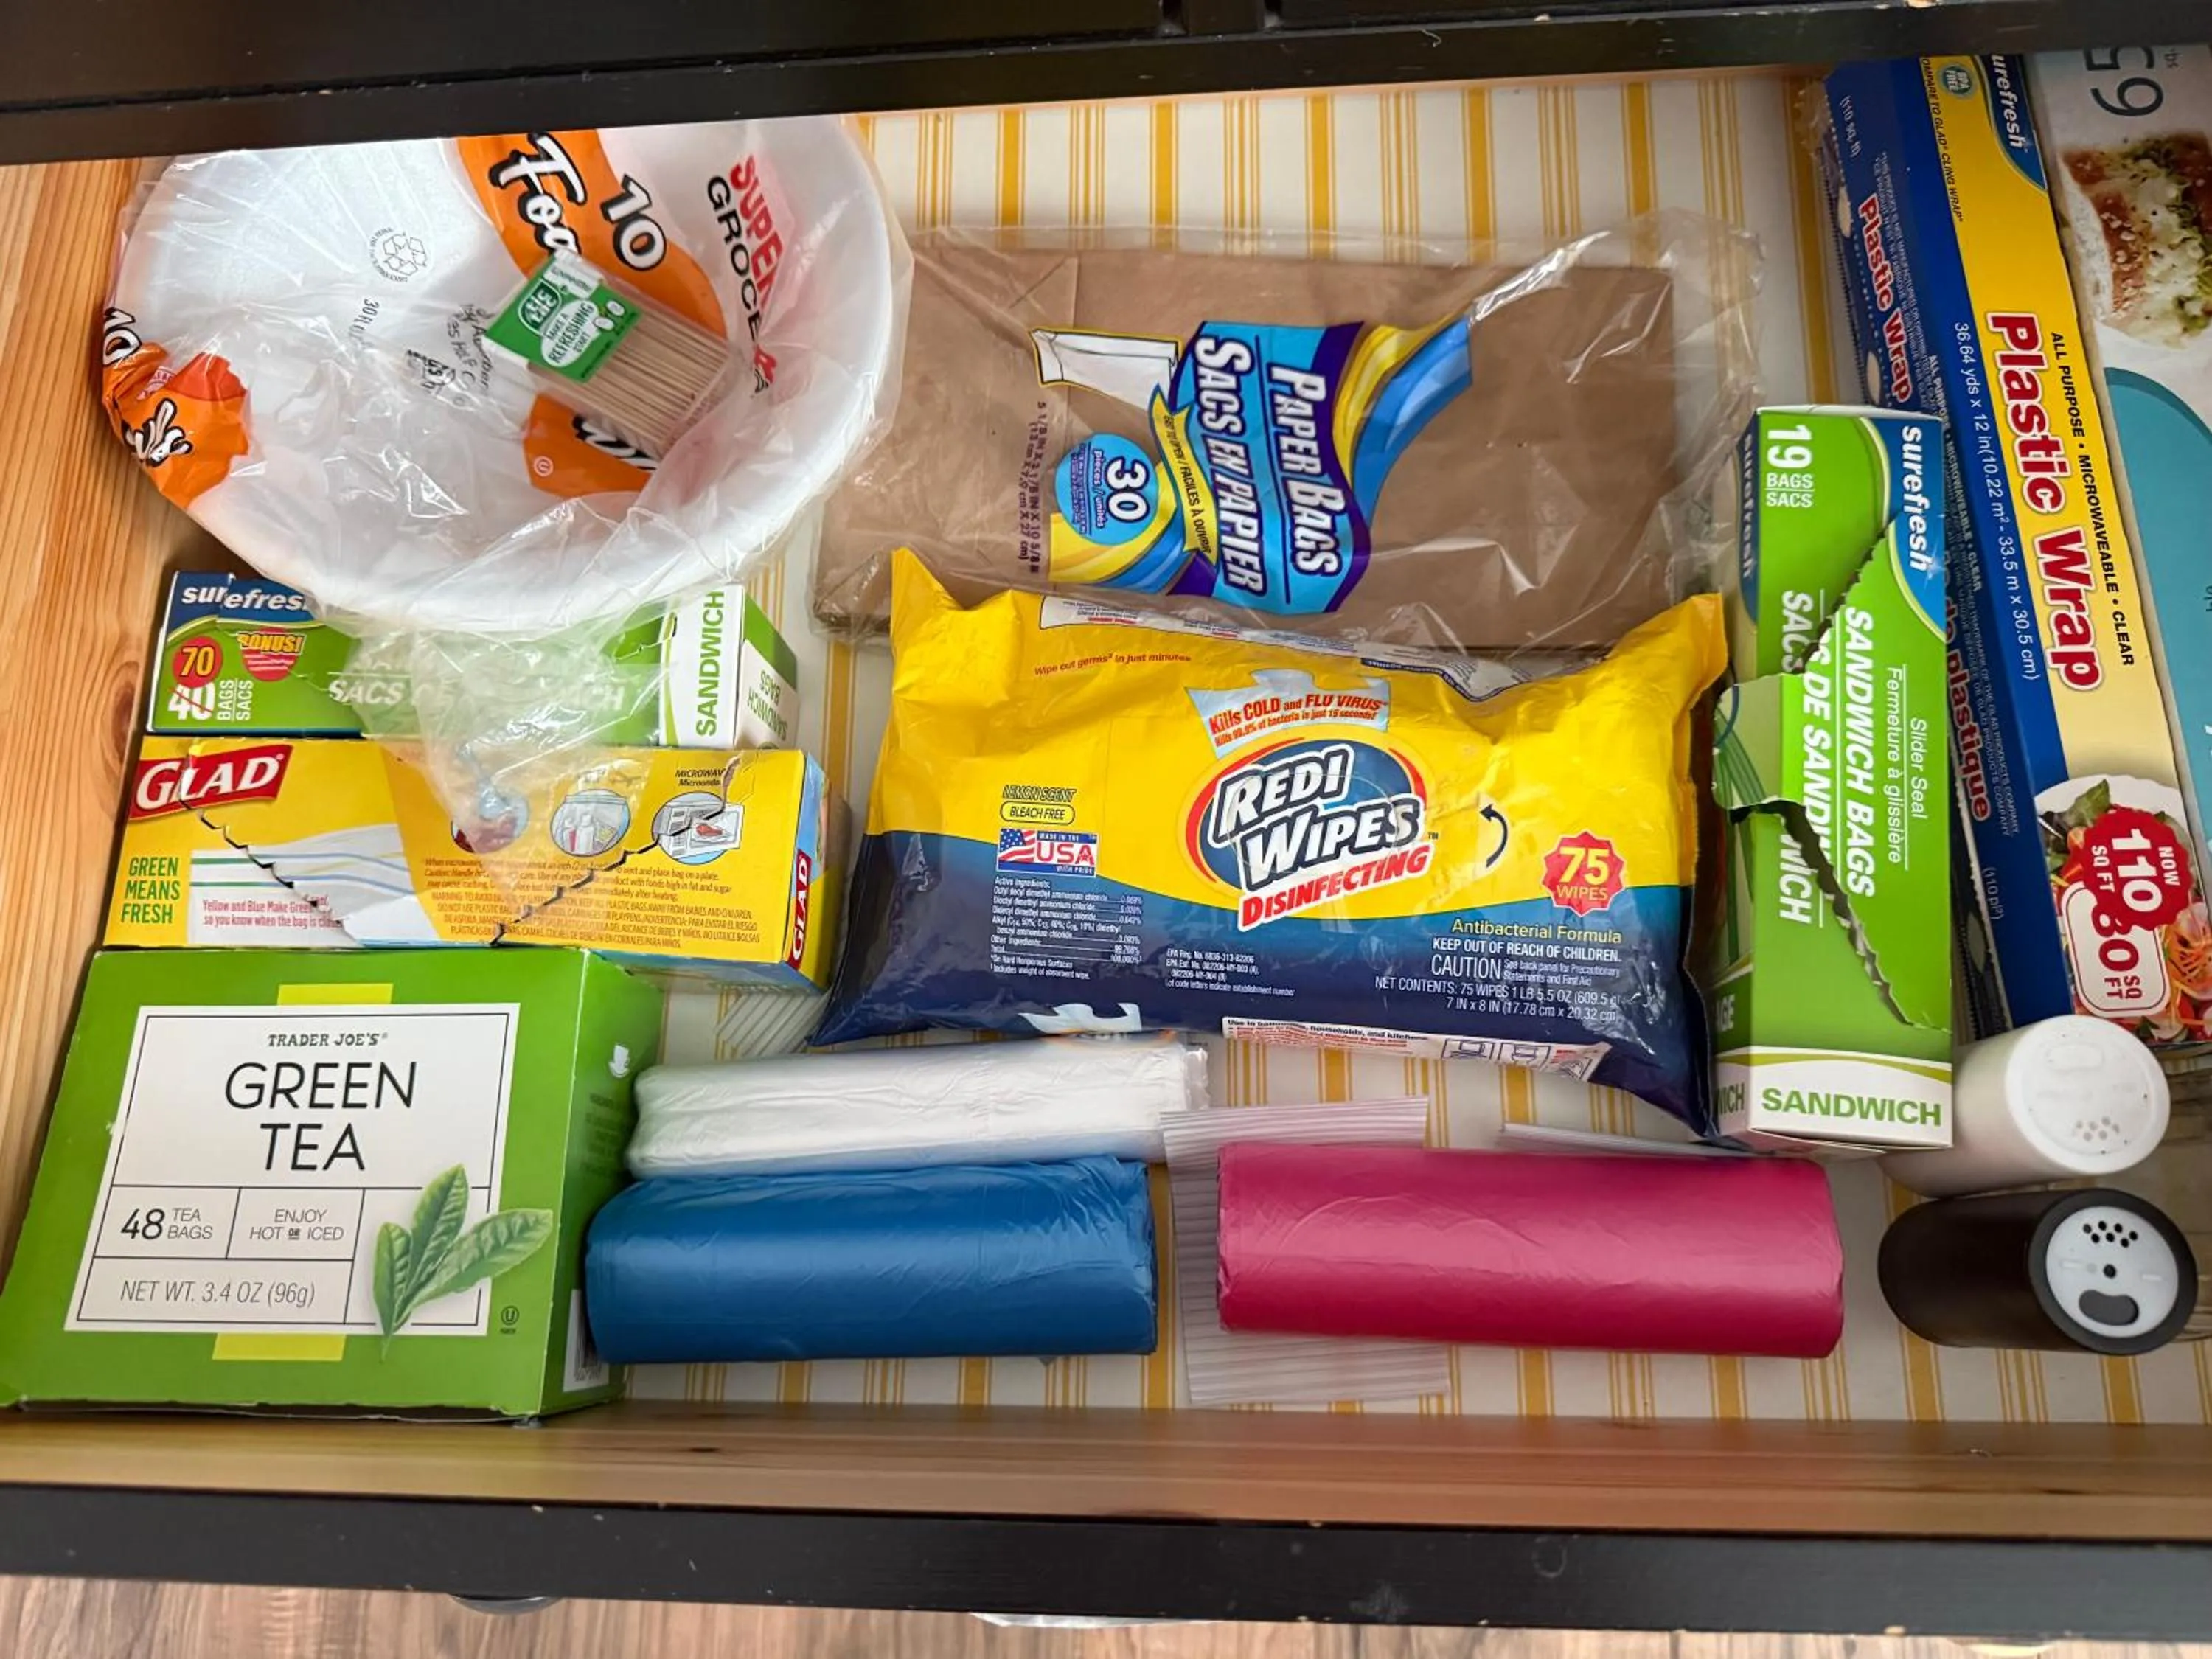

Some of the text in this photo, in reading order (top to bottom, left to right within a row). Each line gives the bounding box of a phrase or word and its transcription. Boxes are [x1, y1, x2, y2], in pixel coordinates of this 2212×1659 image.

[1946, 70, 1959, 91] FREE
[1992, 55, 2025, 148] urefresh
[1930, 100, 1956, 185] TO CLING
[490, 133, 586, 254] Foa
[600, 174, 667, 270] 10
[708, 176, 760, 342] GROCE
[1858, 193, 1893, 313] Plastic
[1883, 310, 1914, 403] Wrap
[549, 303, 594, 364] REFRESHING
[1193, 335, 1252, 436] SACS
[1269, 365, 1328, 478] PAPER
[1204, 437, 1248, 478] EN
[1767, 423, 1812, 469] 19
[1092, 449, 1106, 485] pieces
[1180, 465, 1200, 507] FACILES
[1766, 473, 1813, 489] BAGS
[1105, 456, 1150, 523] 30
[1766, 492, 1813, 508] SACS
[1955, 322, 2040, 681] 36.64 yds 12 33.5 m 30.5 cm)
[1987, 313, 2104, 691] Plastic Wrap
[2051, 332, 2135, 665] ALL PURPOSE MICROWAVEABLE CLEAR
[1018, 492, 1029, 560] cm X 27 cm)
[1030, 496, 1040, 539] IN X 10
[1212, 474, 1268, 596] PAPIER
[1288, 479, 1346, 576] BAGS
[1967, 552, 1982, 592] CLEAR
[181, 586, 307, 611] surefres
[182, 646, 215, 677] 70
[237, 631, 305, 654] BONUS!
[695, 591, 726, 737] SANDWICH
[1034, 653, 1146, 676] Wipe out just
[168, 682, 216, 720] 40
[217, 679, 234, 720] BAGS
[237, 679, 254, 720] SACS
[747, 669, 788, 741] SANDWICH BAGS
[1209, 710, 1242, 735] Kills
[1243, 698, 1281, 721] COLD
[1284, 698, 1302, 710] and
[1305, 694, 1335, 708] FLU
[1802, 675, 1831, 721] DE
[1885, 667, 1904, 762] Fermeture
[1258, 709, 1338, 729] of bacteria in just 15
[1947, 649, 1991, 822] plastique
[1845, 606, 1875, 897] SANDWICH BAGS
[1910, 717, 1929, 820] Slider Seal
[136, 755, 275, 811] GLAD
[675, 768, 723, 779] MICROWAV
[1009, 806, 1066, 821] BLEACH FREE
[1215, 750, 1347, 841] REDI
[1882, 782, 1902, 864] glissière
[1035, 841, 1096, 866] USA
[1242, 796, 1423, 891] WIPES
[128, 856, 179, 877] GREEN
[639, 868, 653, 877] and
[1559, 846, 1610, 885] 75
[2092, 846, 2115, 894] SQ FT
[2110, 828, 2163, 913] 110
[2157, 846, 2180, 886] NOW
[125, 880, 181, 900] MEANS
[203, 900, 288, 913] Yellow and Blue Make
[1242, 846, 1431, 927] DISINFECTING
[1557, 885, 1609, 901] WIPES
[120, 902, 173, 924] FRESH
[204, 914, 307, 929] so you know when the bag
[791, 859, 810, 961] GLAD
[1433, 938, 1623, 963] KEEP OUT OF REACH OF CHILDREN.
[1452, 918, 1623, 944] Antibacterial Formula
[1431, 953, 1502, 981] CAUTION
[1503, 959, 1621, 979] See back panel for Precautionary
[1503, 971, 1578, 986] Statements and First
[1375, 975, 1609, 1007] NET CONTENTS: 75 WIPES LB 5.5 OZ (609.5
[2104, 977, 2123, 999] FT
[2124, 975, 2144, 1001] SQ
[1456, 997, 1468, 1011] IN
[1489, 1000, 1501, 1013] IN
[1502, 1000, 1537, 1018] (17.78
[1538, 1004, 1555, 1017] cm
[1567, 1005, 1599, 1021] 20.32
[268, 1033, 330, 1048] TRADER
[224, 1060, 417, 1110] GREEN
[1761, 1087, 1942, 1127] SANDWICH
[259, 1123, 366, 1172] TEA
[120, 1208, 166, 1241] 48
[167, 1224, 214, 1241] BAGS
[170, 1207, 202, 1223] TEA
[248, 1225, 285, 1242] HOT
[306, 1225, 345, 1242] ICED
[273, 1208, 328, 1225] ENJOY
[119, 1280, 316, 1308] NET WT. 3.4 OZ (96g)
